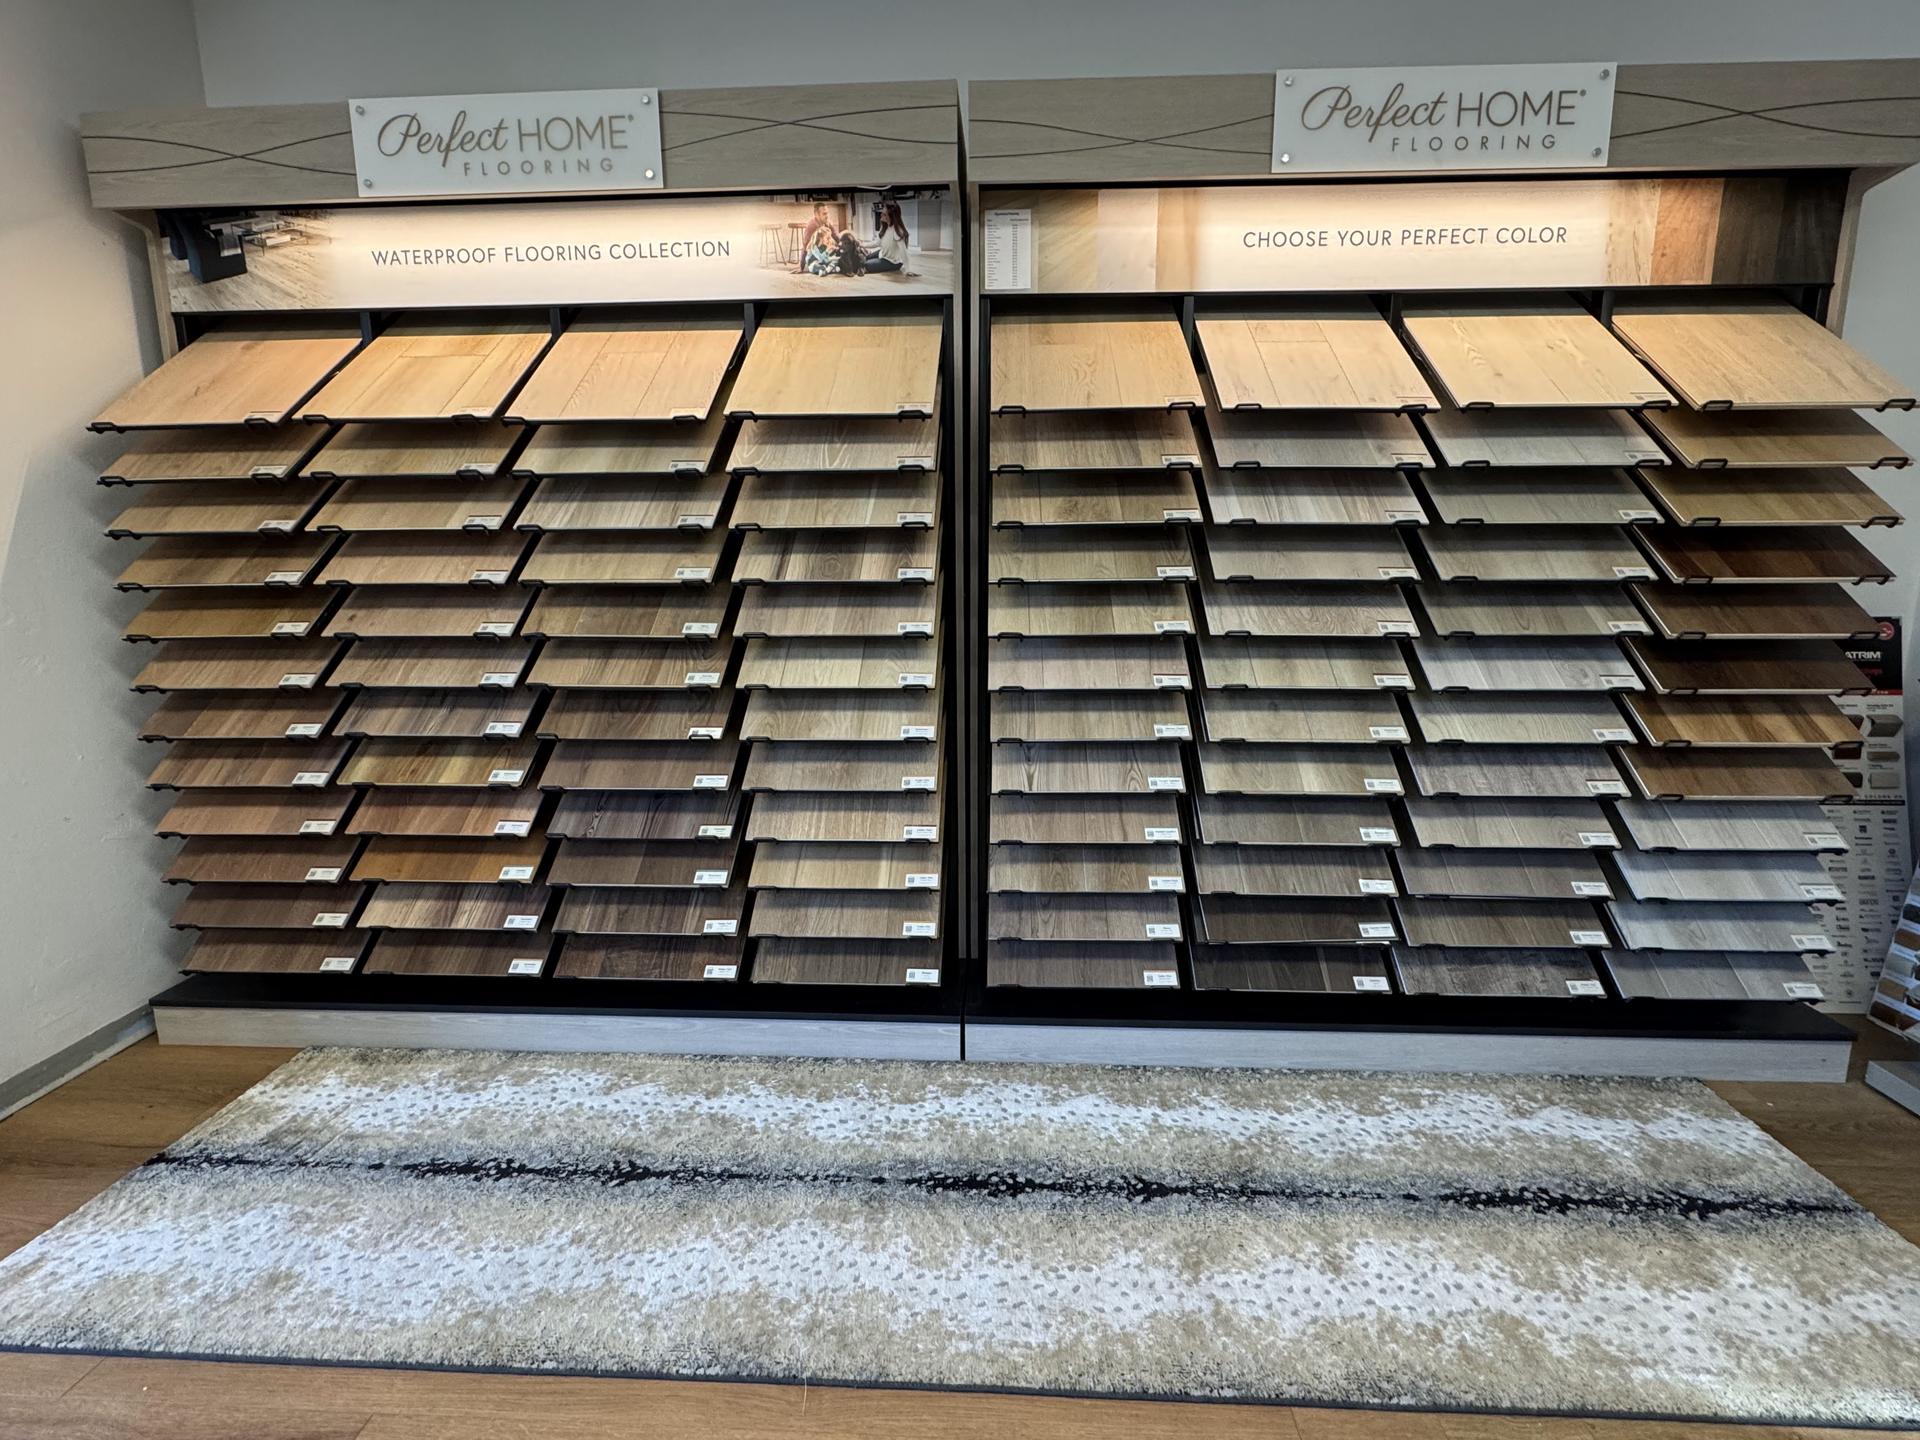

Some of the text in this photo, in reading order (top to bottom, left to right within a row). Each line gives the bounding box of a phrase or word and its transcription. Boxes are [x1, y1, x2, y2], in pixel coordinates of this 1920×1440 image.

[1301, 82, 1448, 143] Perfect
[377, 110, 509, 168] Perfect
[1391, 134, 1556, 152] FLOORING
[463, 157, 614, 177] FLOORING
[1242, 226, 1568, 249] CHOOSE YOUR PERFECT COLOR
[371, 240, 731, 266] WATERPROOF FLOORING COLLECTION
